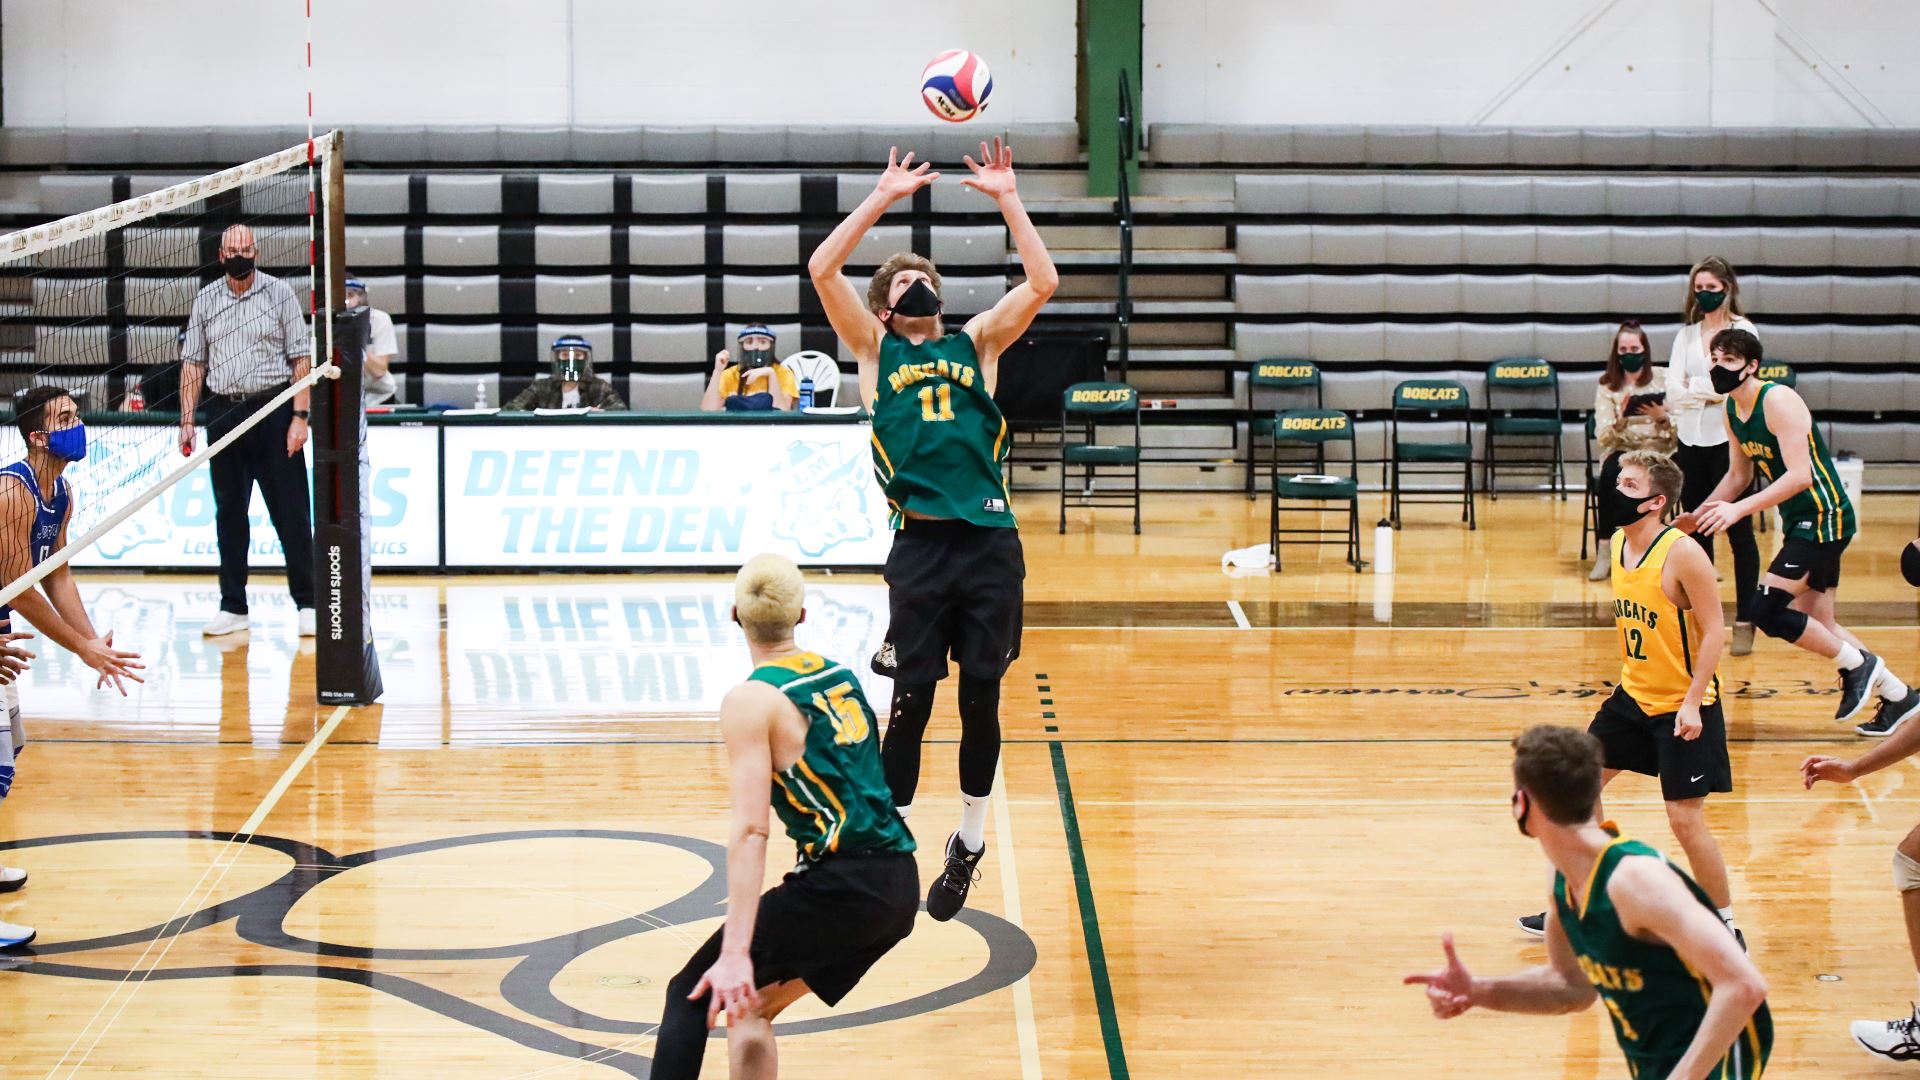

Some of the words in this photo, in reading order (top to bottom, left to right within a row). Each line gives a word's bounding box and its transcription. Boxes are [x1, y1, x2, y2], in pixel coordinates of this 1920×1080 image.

[888, 359, 975, 394] BOBCATS
[1258, 365, 1314, 378] BOBCATS
[1495, 365, 1550, 378] BOBCATS
[1758, 365, 1789, 379] CATS
[918, 383, 955, 422] 11
[1071, 388, 1131, 403] BOBCATS
[1402, 386, 1460, 401] BOBCATS
[1281, 416, 1347, 431] BOBCATS
[463, 449, 700, 497] DEFEND
[501, 505, 611, 554] THE
[620, 505, 747, 554] DEN
[328, 545, 341, 587] sports
[329, 588, 343, 640] imports
[1623, 627, 1648, 660] 12
[811, 680, 869, 746] 15
